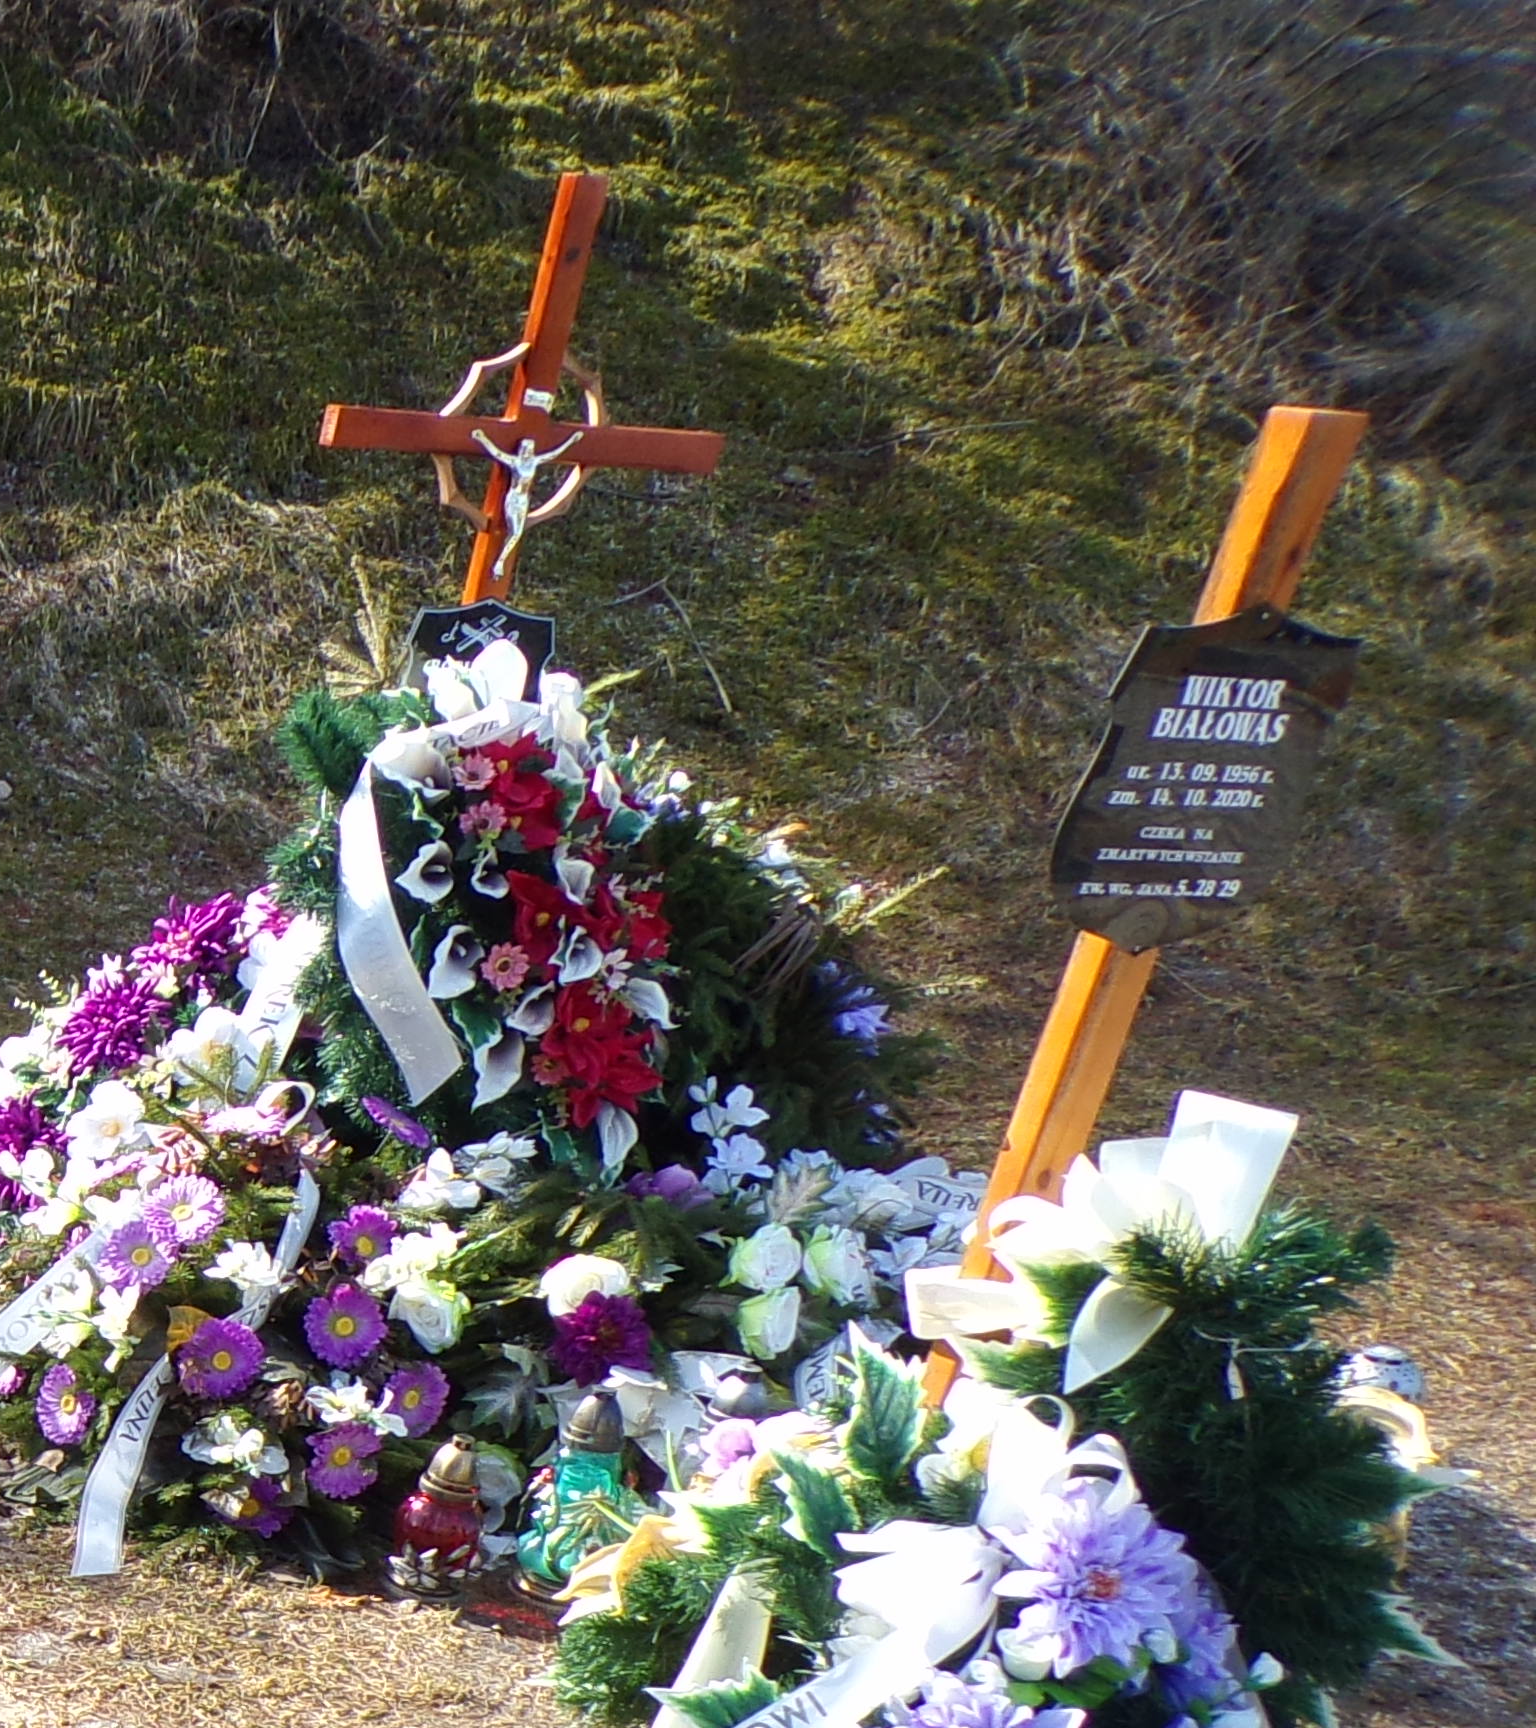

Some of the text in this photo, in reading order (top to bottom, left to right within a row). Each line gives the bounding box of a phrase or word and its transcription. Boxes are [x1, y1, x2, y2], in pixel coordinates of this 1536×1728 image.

[1181, 675, 1287, 710] WIKTOR
[1152, 708, 1290, 746] BIAŁOWĄS
[1127, 766, 1151, 781] ur.
[1159, 762, 1186, 782] 13.
[1191, 763, 1217, 782] 09.
[1108, 790, 1141, 806] zm.
[1149, 788, 1176, 806] 14.
[1183, 788, 1208, 807] 10.
[1212, 789, 1252, 807] 2020
